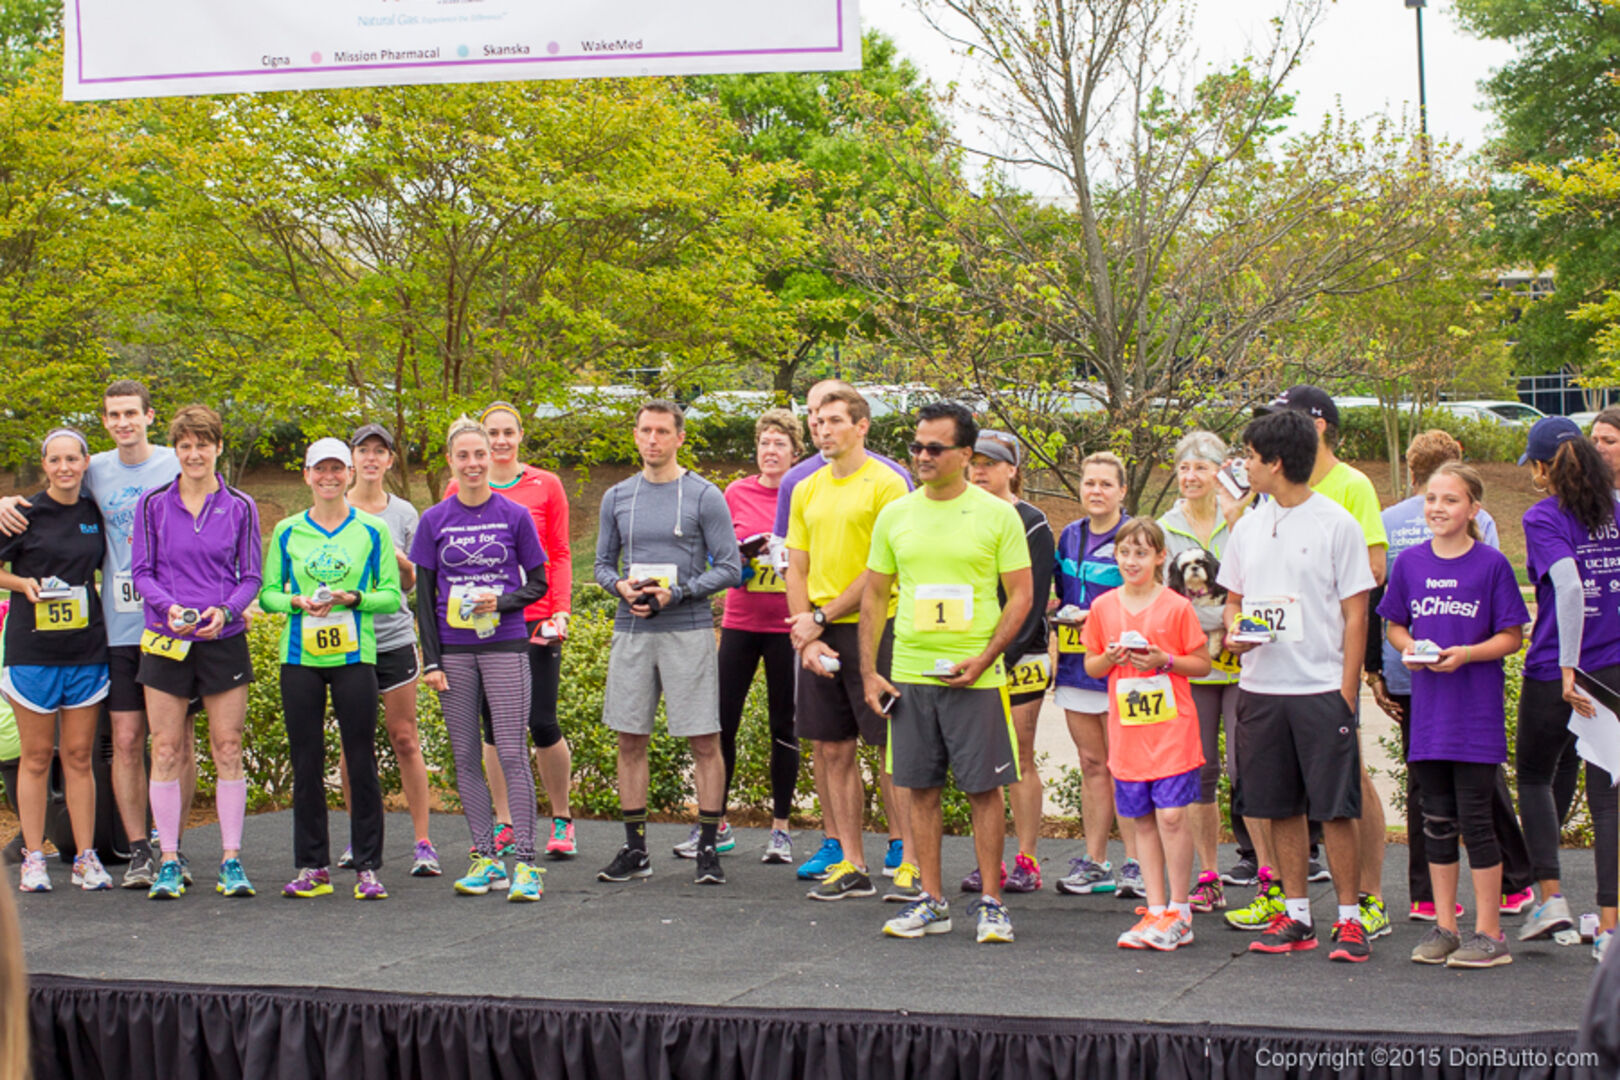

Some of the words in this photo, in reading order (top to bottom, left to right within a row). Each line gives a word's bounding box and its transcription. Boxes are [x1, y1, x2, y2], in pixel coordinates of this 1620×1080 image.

[358, 15, 396, 27] Natural
[261, 55, 291, 68] Cigna
[334, 51, 377, 62] Mission
[380, 47, 440, 60] Pharmacal
[483, 43, 530, 56] Skanska
[580, 39, 643, 52] WakeMed
[450, 535, 475, 546] Laps
[479, 533, 496, 543] for
[1425, 577, 1458, 589] team
[49, 602, 72, 624] 55
[935, 602, 946, 623] 1
[316, 627, 341, 649] 68
[1009, 663, 1046, 687] 121
[1127, 693, 1163, 717] 147
